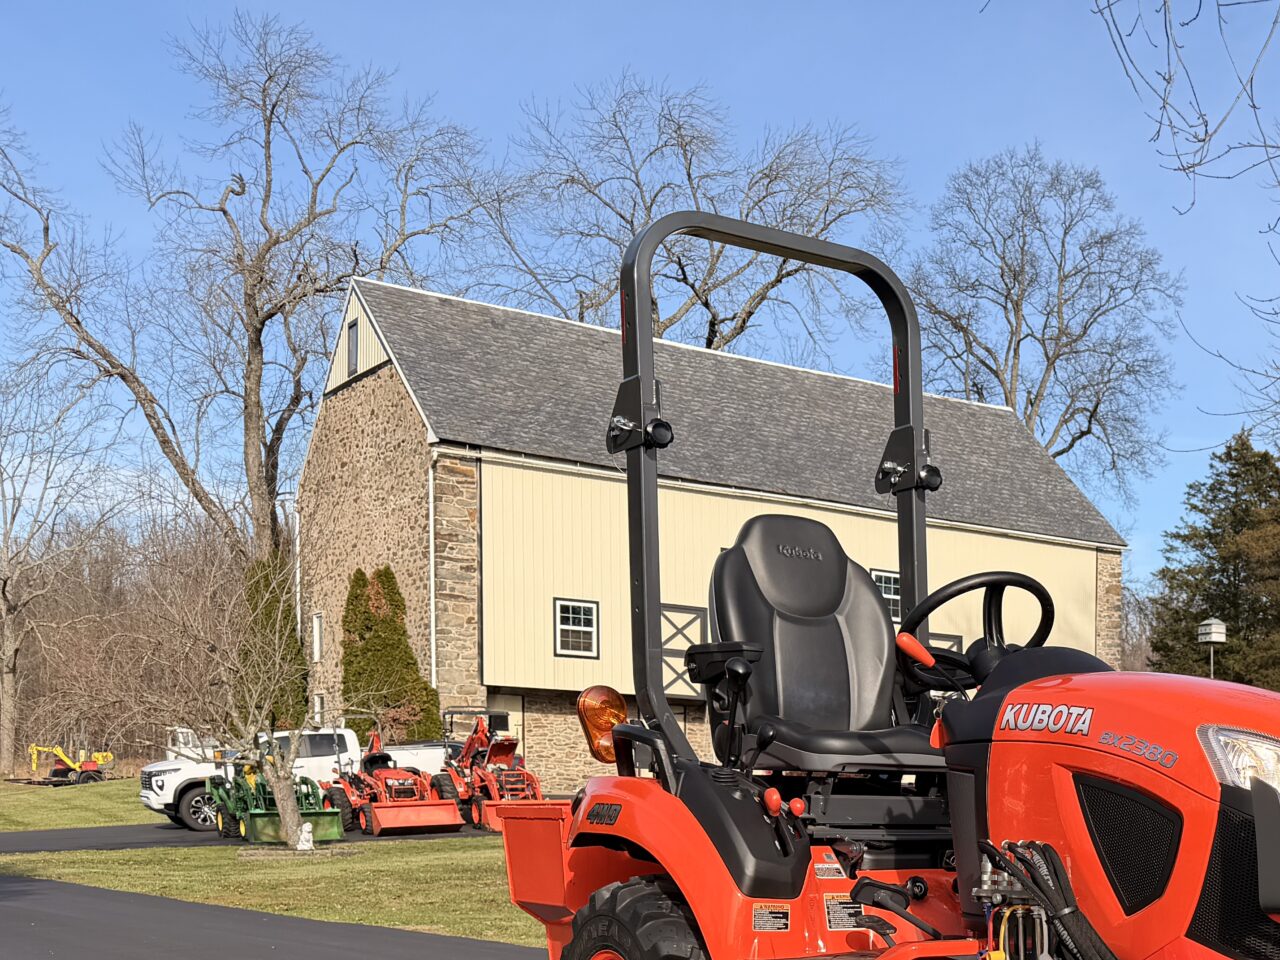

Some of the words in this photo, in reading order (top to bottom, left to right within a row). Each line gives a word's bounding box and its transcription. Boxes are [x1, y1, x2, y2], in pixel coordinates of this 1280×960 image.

[776, 544, 823, 561] Kubota
[999, 703, 1094, 736] KUBOTA
[1099, 731, 1179, 769] BX2380
[586, 802, 622, 826] 4WD
